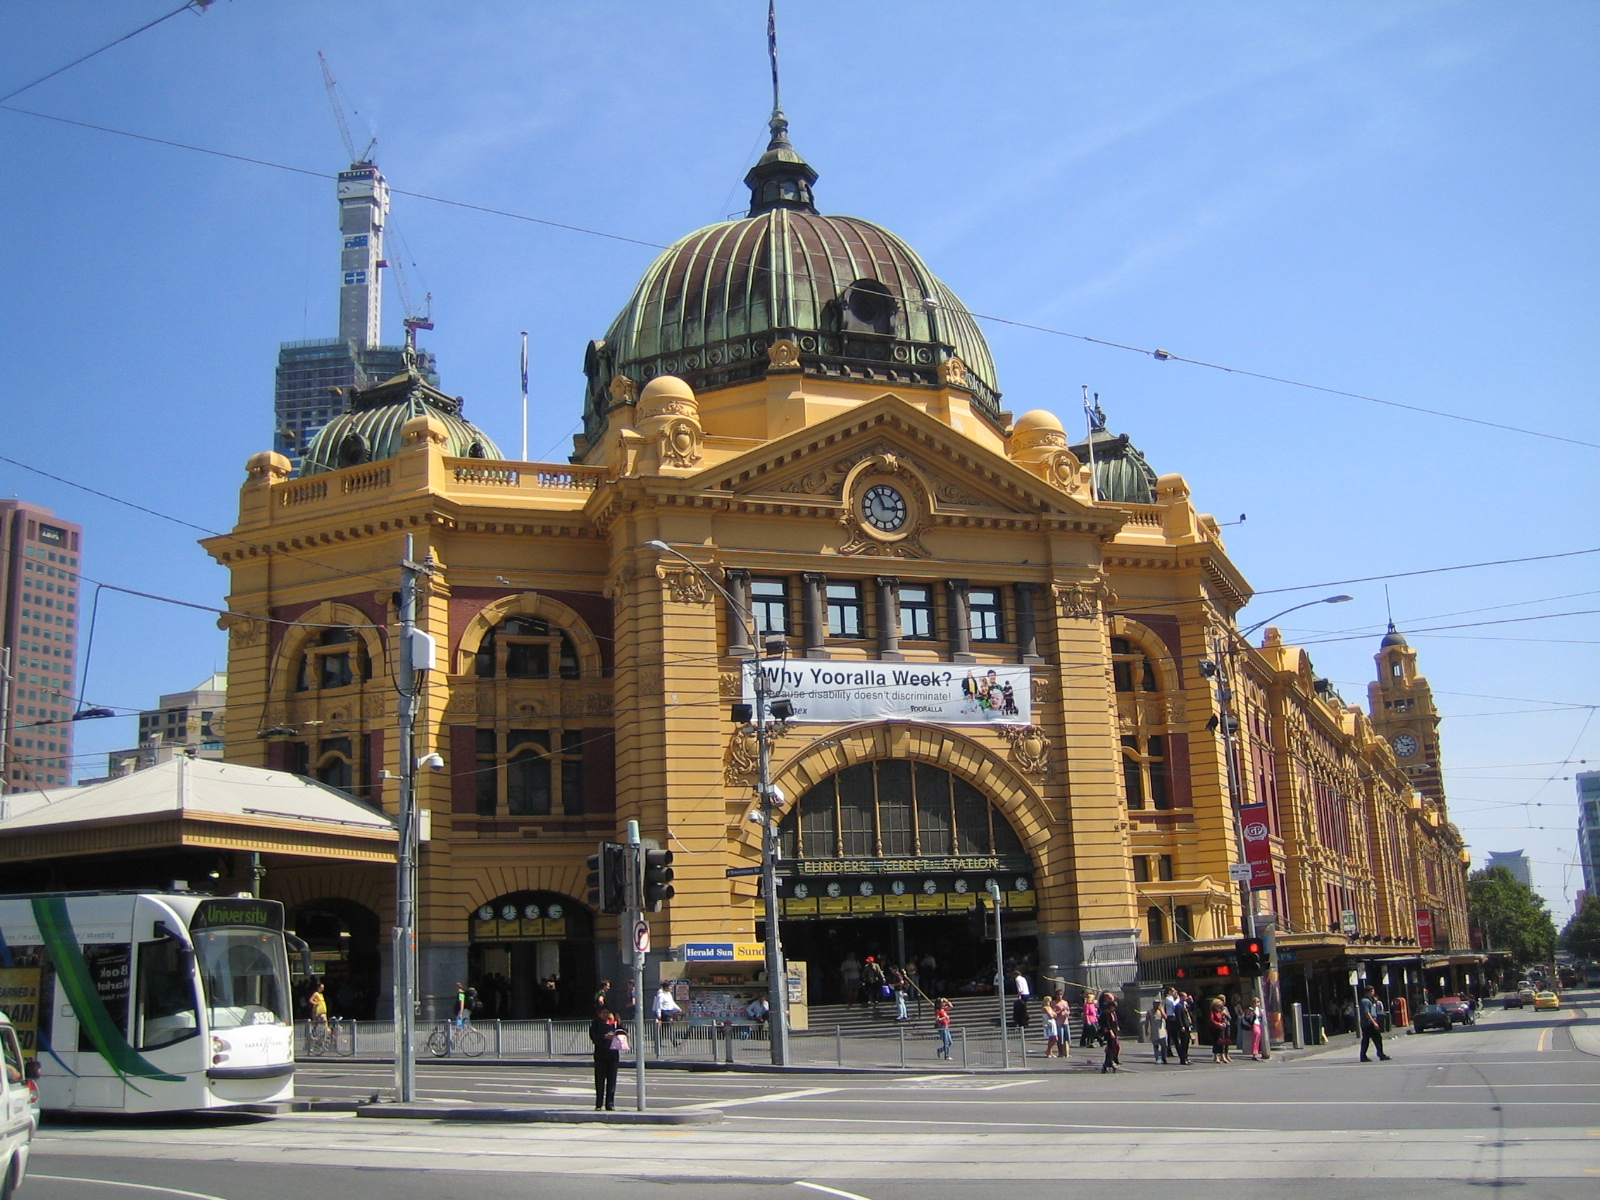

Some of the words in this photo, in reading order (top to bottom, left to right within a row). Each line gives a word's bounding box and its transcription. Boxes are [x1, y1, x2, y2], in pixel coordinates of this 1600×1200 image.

[761, 667, 803, 688] Why
[810, 668, 886, 686] Yooralla
[892, 670, 952, 687] Week?
[808, 689, 850, 701] disability
[854, 691, 889, 700] doesn't
[892, 692, 951, 701] discriminate!
[804, 861, 867, 873] FLINDERS
[883, 860, 929, 871] STREET
[944, 858, 999, 870] STATION
[208, 905, 267, 923] University
[687, 948, 714, 957] Herald
[717, 949, 733, 957] Sun
[738, 946, 764, 956] Sund
[253, 1012, 275, 1023] 3520
